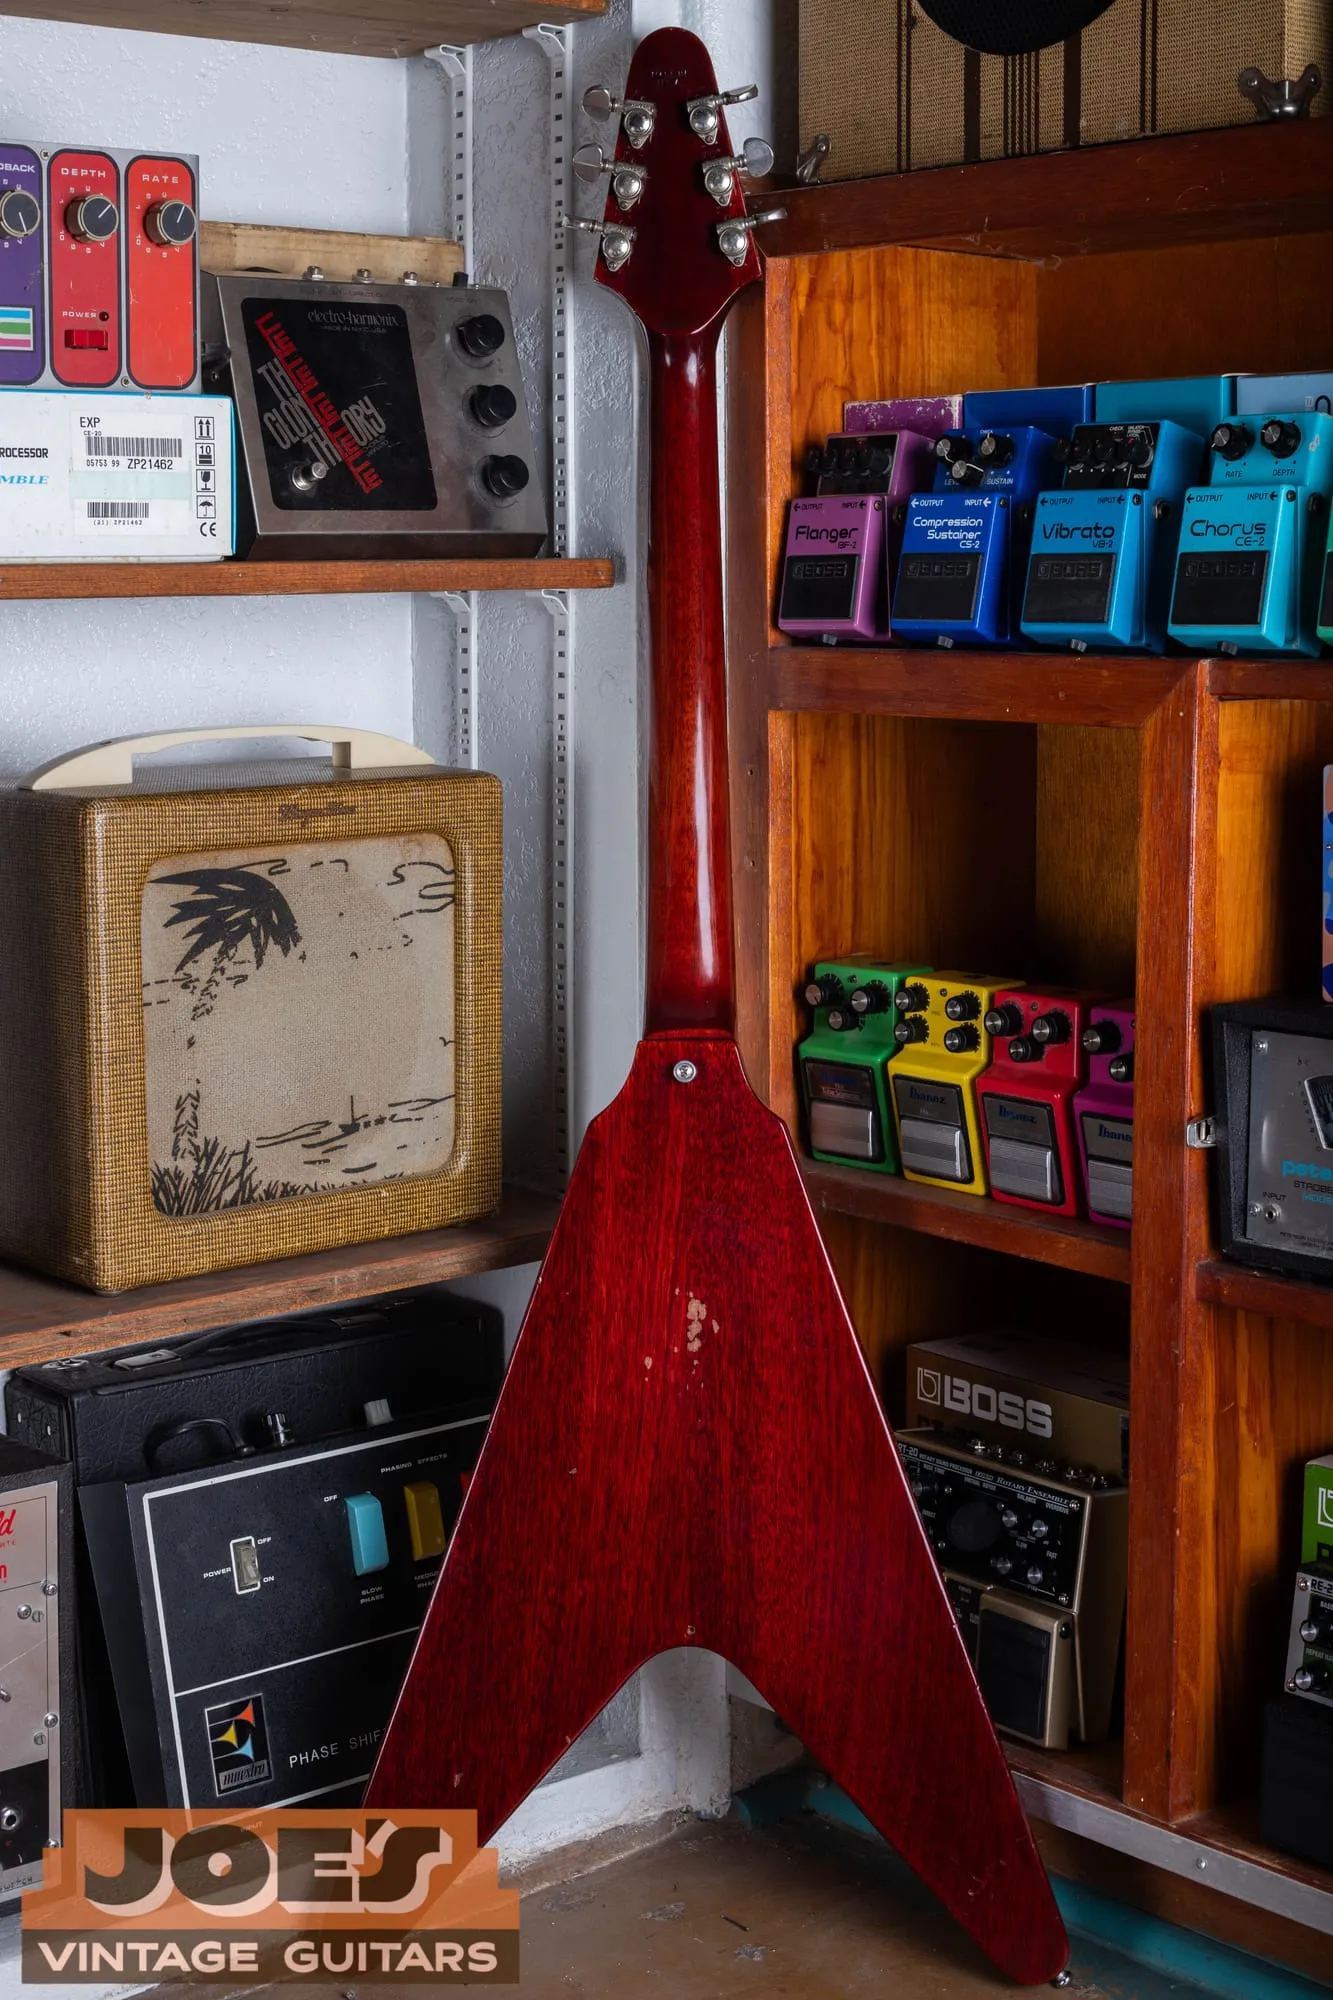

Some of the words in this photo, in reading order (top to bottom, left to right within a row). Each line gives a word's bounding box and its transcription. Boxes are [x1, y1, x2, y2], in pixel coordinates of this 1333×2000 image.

[61, 167, 106, 178] DEPTH
[142, 174, 179, 184] RATE
[62, 310, 97, 318] POWER
[307, 308, 399, 327] electro-harmonix
[79, 416, 101, 428] EXP
[0, 447, 49, 459] ROCESSOR
[200, 445, 211, 455] 10
[86, 459, 107, 467] 05753
[111, 459, 120, 467] 99
[127, 458, 174, 470] ZP21462
[1225, 470, 1243, 478] RATE
[1050, 497, 1074, 505] OUTPUT
[1096, 496, 1116, 504] INPUT
[1195, 494, 1224, 502] OUTPUT
[1247, 492, 1269, 501] INPUT
[801, 503, 823, 511] OUTPUT
[920, 499, 944, 507] OUTPUT
[913, 516, 983, 529] Compression
[1190, 519, 1267, 537] Chorus
[795, 524, 859, 544] Flanger
[927, 529, 981, 540] Sustainer
[1042, 522, 1115, 540] Vibrato
[838, 540, 857, 550] BF-2
[959, 539, 980, 549] CS-2
[1092, 539, 1113, 549] VB-2
[1235, 536, 1265, 547] CE-2
[1098, 1124, 1133, 1142] Ibane
[1282, 1160, 1333, 1181] pete
[1262, 1191, 1287, 1201] INPUT
[944, 1374, 1053, 1439] BOSS
[380, 1461, 413, 1474] PHASING
[417, 1453, 448, 1465] EFFECTS
[323, 1494, 338, 1502] OFF
[257, 1536, 272, 1545] OFF
[203, 1566, 231, 1579] POWER
[263, 1575, 275, 1583] ON
[361, 1585, 383, 1596] SLOW
[360, 1593, 385, 1605] PHASE
[288, 1743, 339, 1768] PHASE
